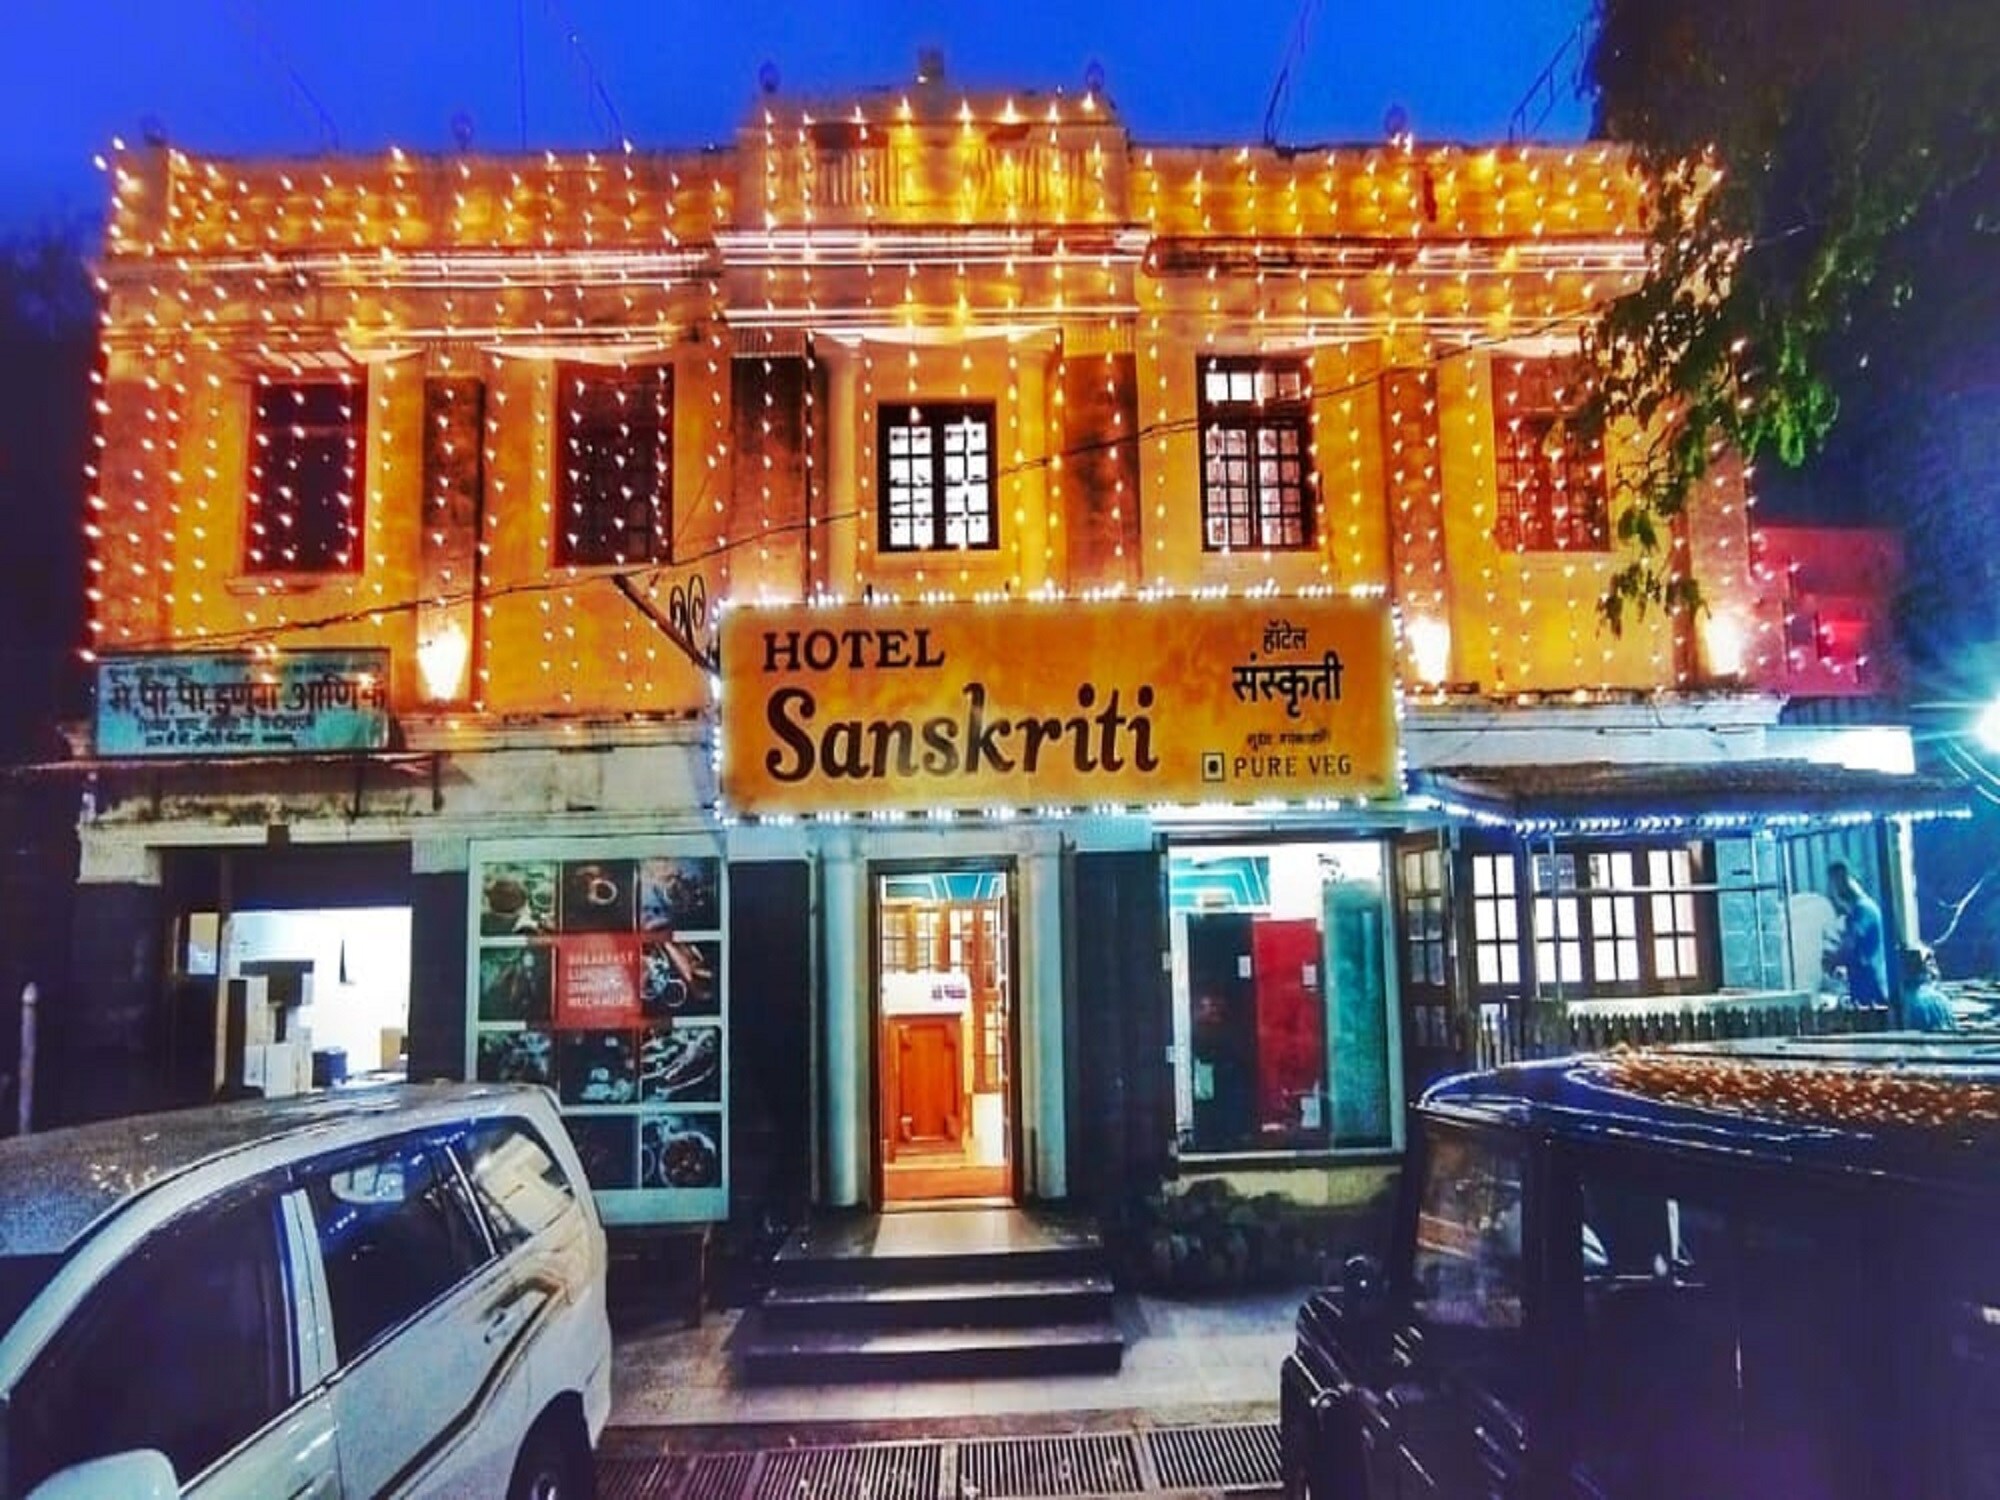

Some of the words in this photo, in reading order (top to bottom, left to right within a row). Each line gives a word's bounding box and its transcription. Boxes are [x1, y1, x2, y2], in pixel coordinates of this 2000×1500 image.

[762, 628, 945, 673] HOTEL
[1263, 620, 1308, 653] हॉटेल
[1232, 650, 1344, 718] संस्कृती
[766, 682, 1158, 782] Sanskriti
[1234, 756, 1297, 778] PURE
[1308, 754, 1351, 776] VEG
